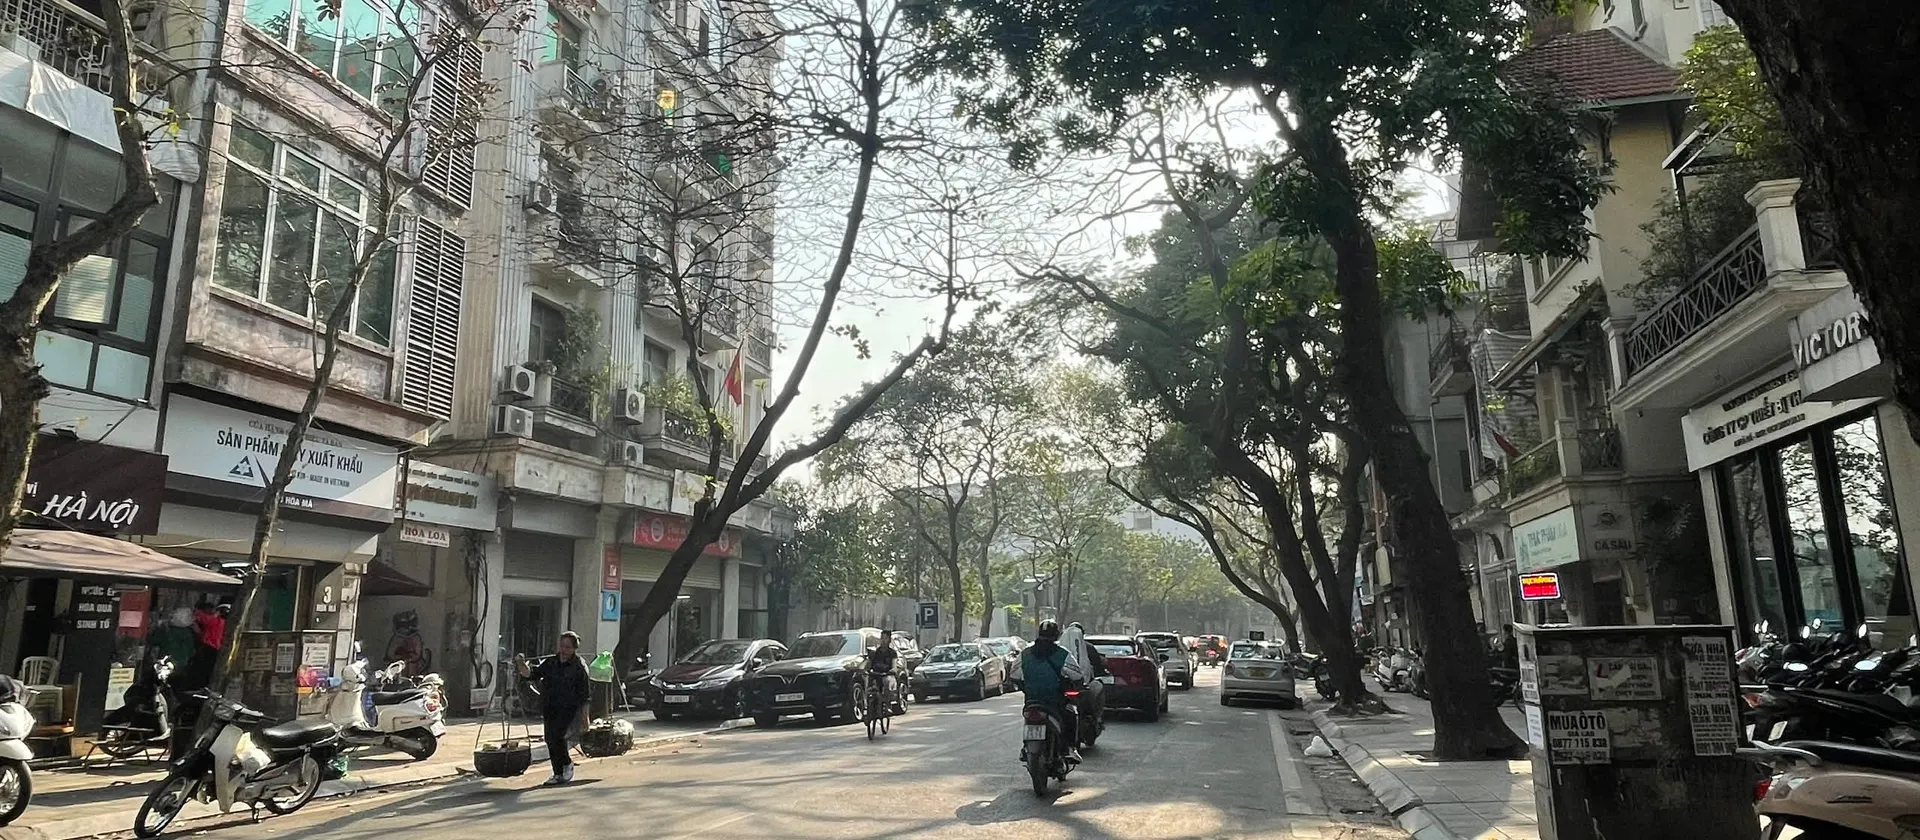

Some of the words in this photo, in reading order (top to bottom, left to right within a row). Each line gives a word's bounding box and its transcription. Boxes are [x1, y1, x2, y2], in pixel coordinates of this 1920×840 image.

[216, 426, 243, 449] SẢN
[245, 433, 279, 457] PHẨM
[308, 449, 335, 470] XUẤT
[336, 453, 363, 474] KHẨU
[27, 482, 38, 498] vị
[41, 490, 88, 520] HÀ
[88, 497, 140, 528] NỘI
[323, 586, 332, 604] 3
[924, 607, 934, 621] P
[99, 618, 111, 629] TỐ
[1575, 737, 1590, 748] 115
